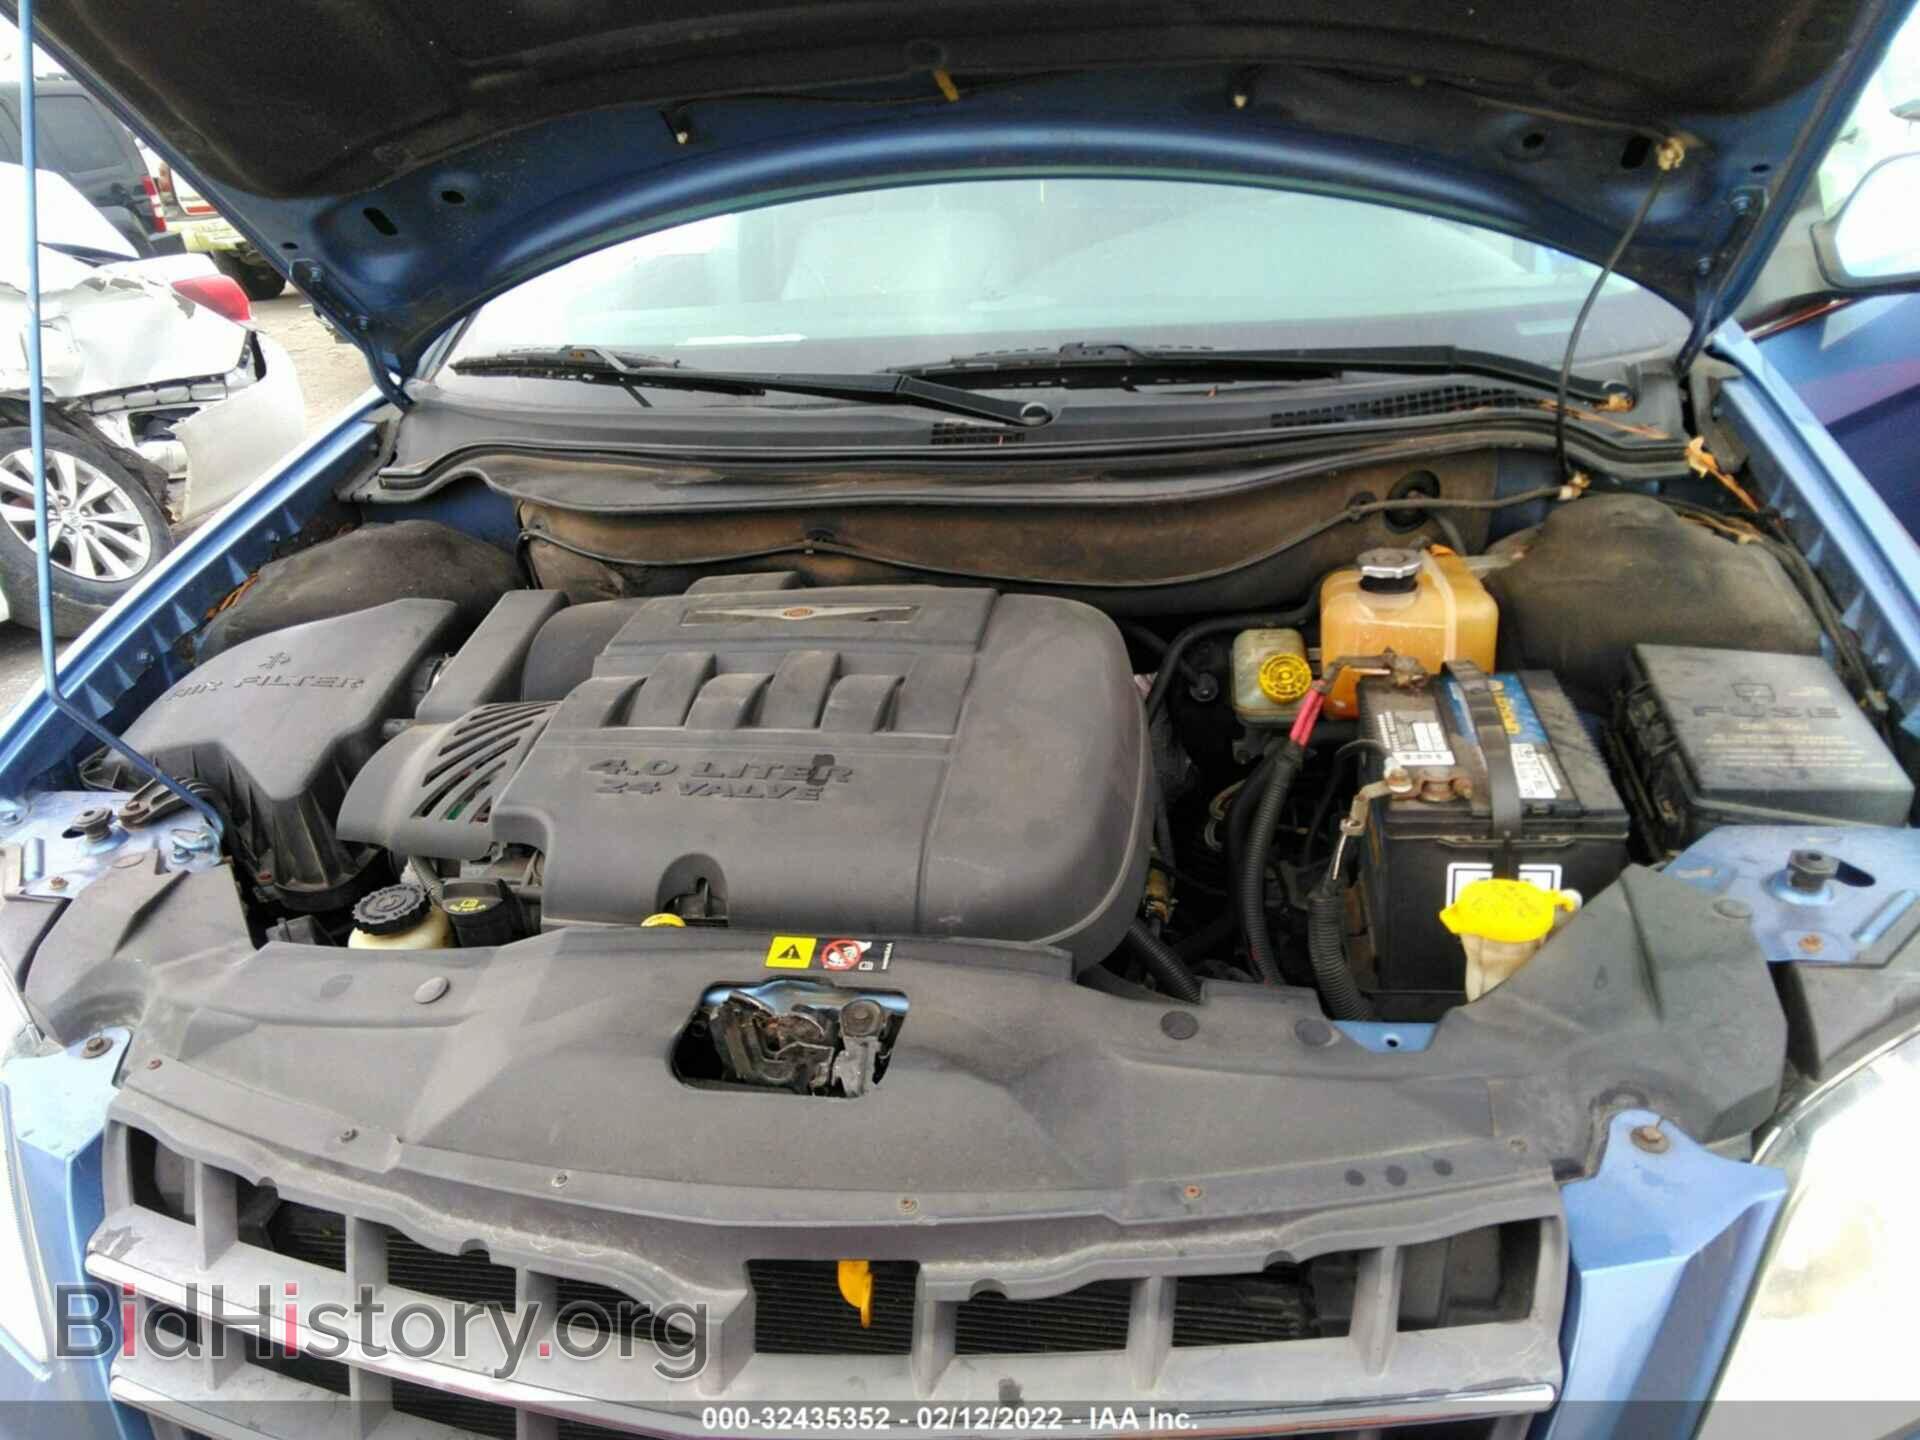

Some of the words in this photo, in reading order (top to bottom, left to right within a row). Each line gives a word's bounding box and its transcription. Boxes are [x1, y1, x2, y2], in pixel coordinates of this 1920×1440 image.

[233, 674, 366, 690] FILTER
[1693, 705, 1841, 719] FUSE
[587, 759, 680, 777] 4.0
[690, 761, 854, 784] LITER
[595, 780, 662, 795] 24
[677, 782, 825, 801] VALVE
